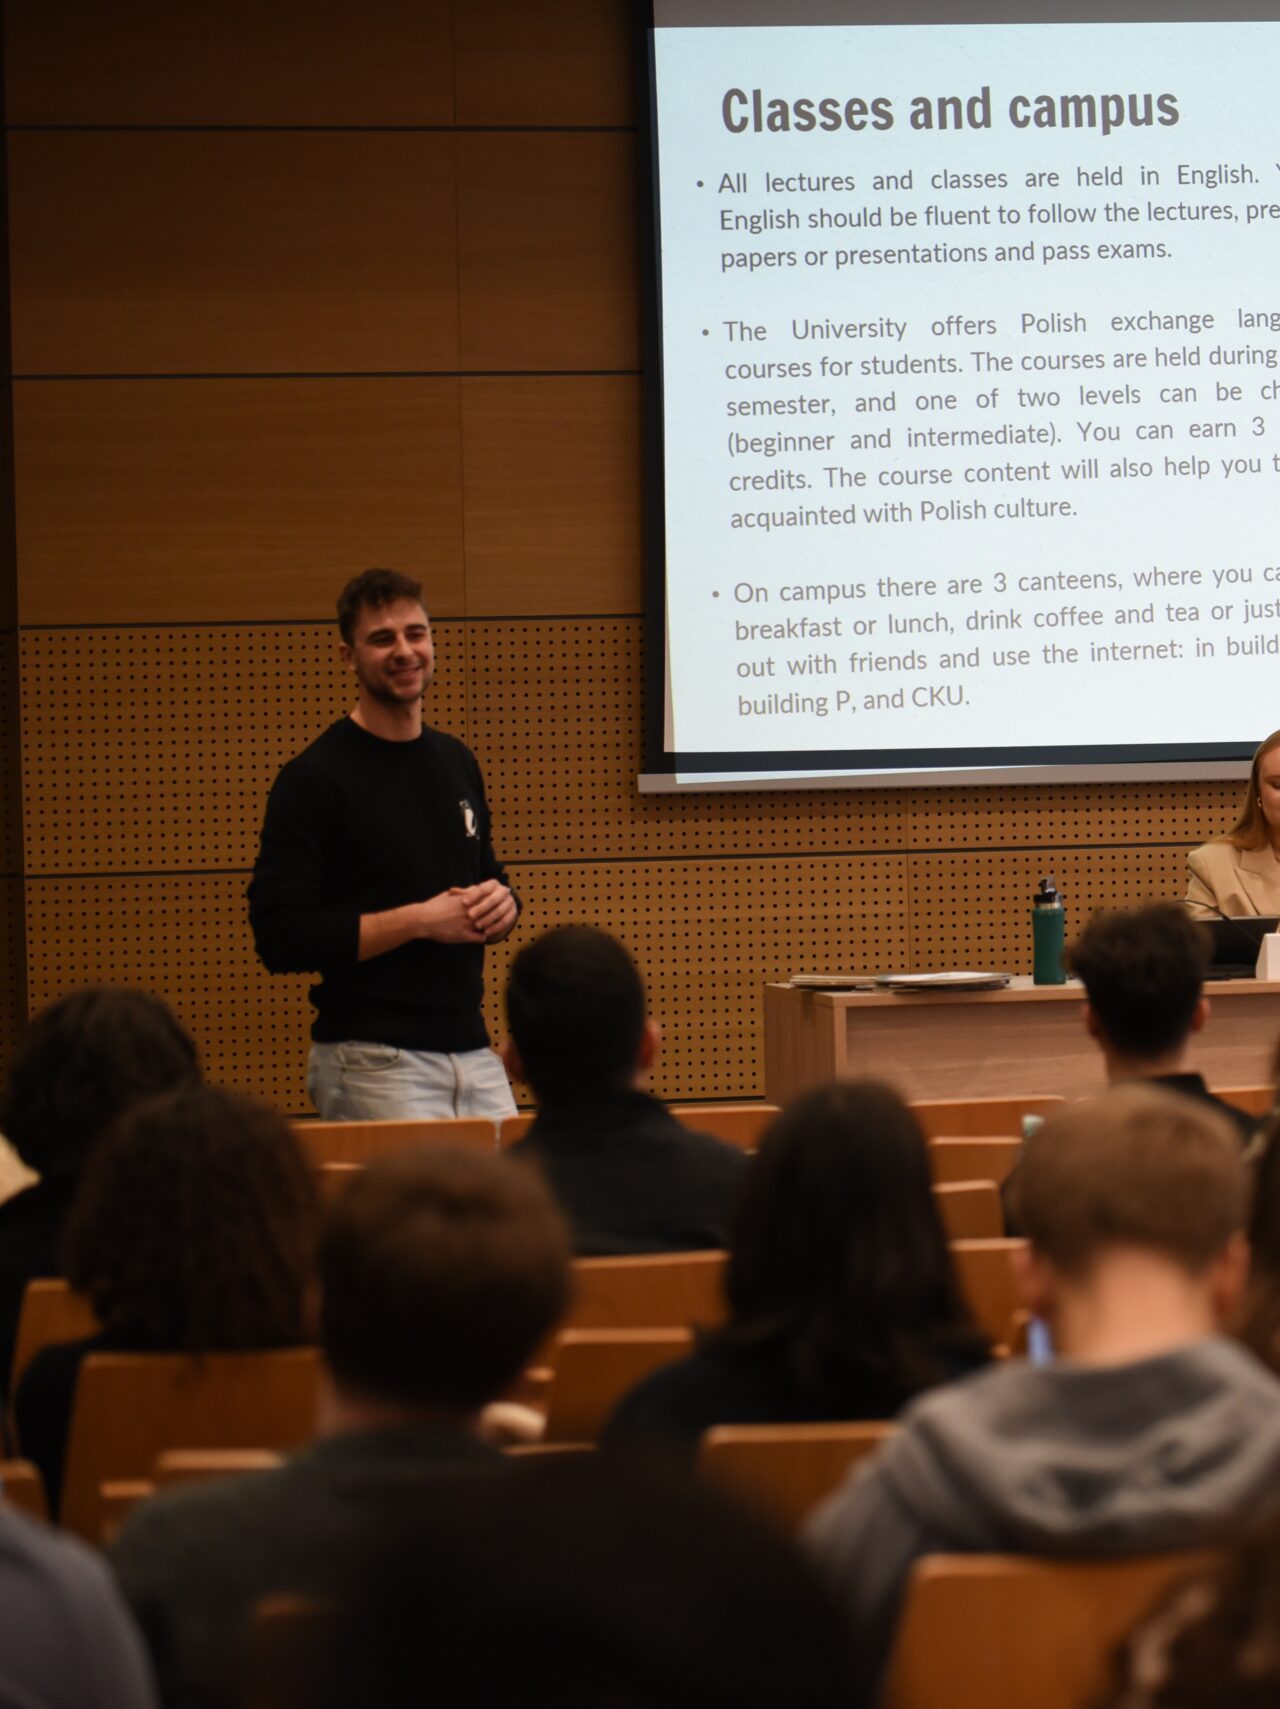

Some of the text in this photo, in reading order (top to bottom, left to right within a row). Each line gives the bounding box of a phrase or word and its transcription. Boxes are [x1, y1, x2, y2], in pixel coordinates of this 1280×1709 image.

[721, 85, 1180, 135] Classes and campus
[717, 172, 748, 195] All
[765, 171, 856, 193] lectures
[872, 168, 914, 191] and
[930, 168, 1009, 190] classes
[1024, 171, 1060, 188] are
[1076, 165, 1124, 188] held
[1140, 164, 1160, 186] in
[1177, 163, 1260, 190] English.
[719, 207, 801, 235] English
[807, 205, 883, 229] should
[889, 205, 918, 228] be
[923, 204, 992, 227] fluent
[996, 204, 1022, 225] to
[1026, 202, 1097, 225] follow
[1103, 201, 1141, 223] the
[1146, 200, 1239, 224] lectures,
[720, 239, 1173, 274] papers or presentations and pass exams.
[722, 320, 768, 343] The
[791, 316, 908, 343] University
[930, 314, 998, 337] offers
[1020, 311, 1087, 335] Polish
[1110, 309, 1215, 335] exchange
[724, 361, 813, 380] courses
[818, 355, 854, 377] for
[860, 353, 964, 376] students.
[969, 351, 1014, 373] The
[1020, 353, 1106, 372] courses
[1112, 352, 1148, 369] are
[1154, 345, 1201, 368] held
[1208, 344, 1279, 369] during
[726, 394, 836, 417] semester,
[854, 390, 897, 413] and
[914, 394, 958, 411] one
[975, 387, 1000, 409] of
[1017, 387, 1061, 408] two
[1079, 383, 1142, 406] levels
[1159, 386, 1197, 404] can
[1215, 380, 1243, 402] be
[727, 431, 836, 458] (beginner
[850, 427, 892, 450] and
[906, 421, 1062, 449] intermediate).
[1075, 420, 1121, 443] You
[1135, 424, 1174, 441] can
[1188, 421, 1237, 439] earn
[1251, 415, 1266, 437] 3
[728, 468, 813, 492] credits.
[822, 466, 867, 489] The
[877, 468, 953, 487] course
[963, 460, 1051, 484] content
[1060, 457, 1099, 481] will
[1109, 456, 1154, 479] also
[1164, 454, 1211, 481] help
[1220, 457, 1262, 480] you
[730, 496, 1078, 533] acquainted with Polish culture.
[733, 582, 769, 604] On
[779, 582, 867, 605] campus
[876, 576, 937, 598] there
[946, 578, 983, 596] are
[993, 571, 1007, 593] 3
[1017, 570, 1123, 592] canteens,
[1132, 565, 1203, 588] where
[1211, 567, 1253, 589] you
[735, 616, 843, 641] breakfast
[852, 619, 878, 636] or
[888, 611, 955, 636] lunch,
[965, 608, 1023, 631] drink
[1033, 605, 1104, 628] coffee
[1114, 602, 1155, 625] and
[1164, 602, 1200, 623] tea
[1210, 604, 1234, 621] or
[736, 656, 776, 679] out
[786, 652, 837, 676] with
[848, 649, 928, 673] friends
[938, 646, 980, 669] and
[992, 649, 1031, 667] use
[1041, 642, 1079, 665] the
[1089, 639, 1184, 663] internet:
[1195, 636, 1215, 658] in
[738, 684, 970, 718] building P, and CKU.
